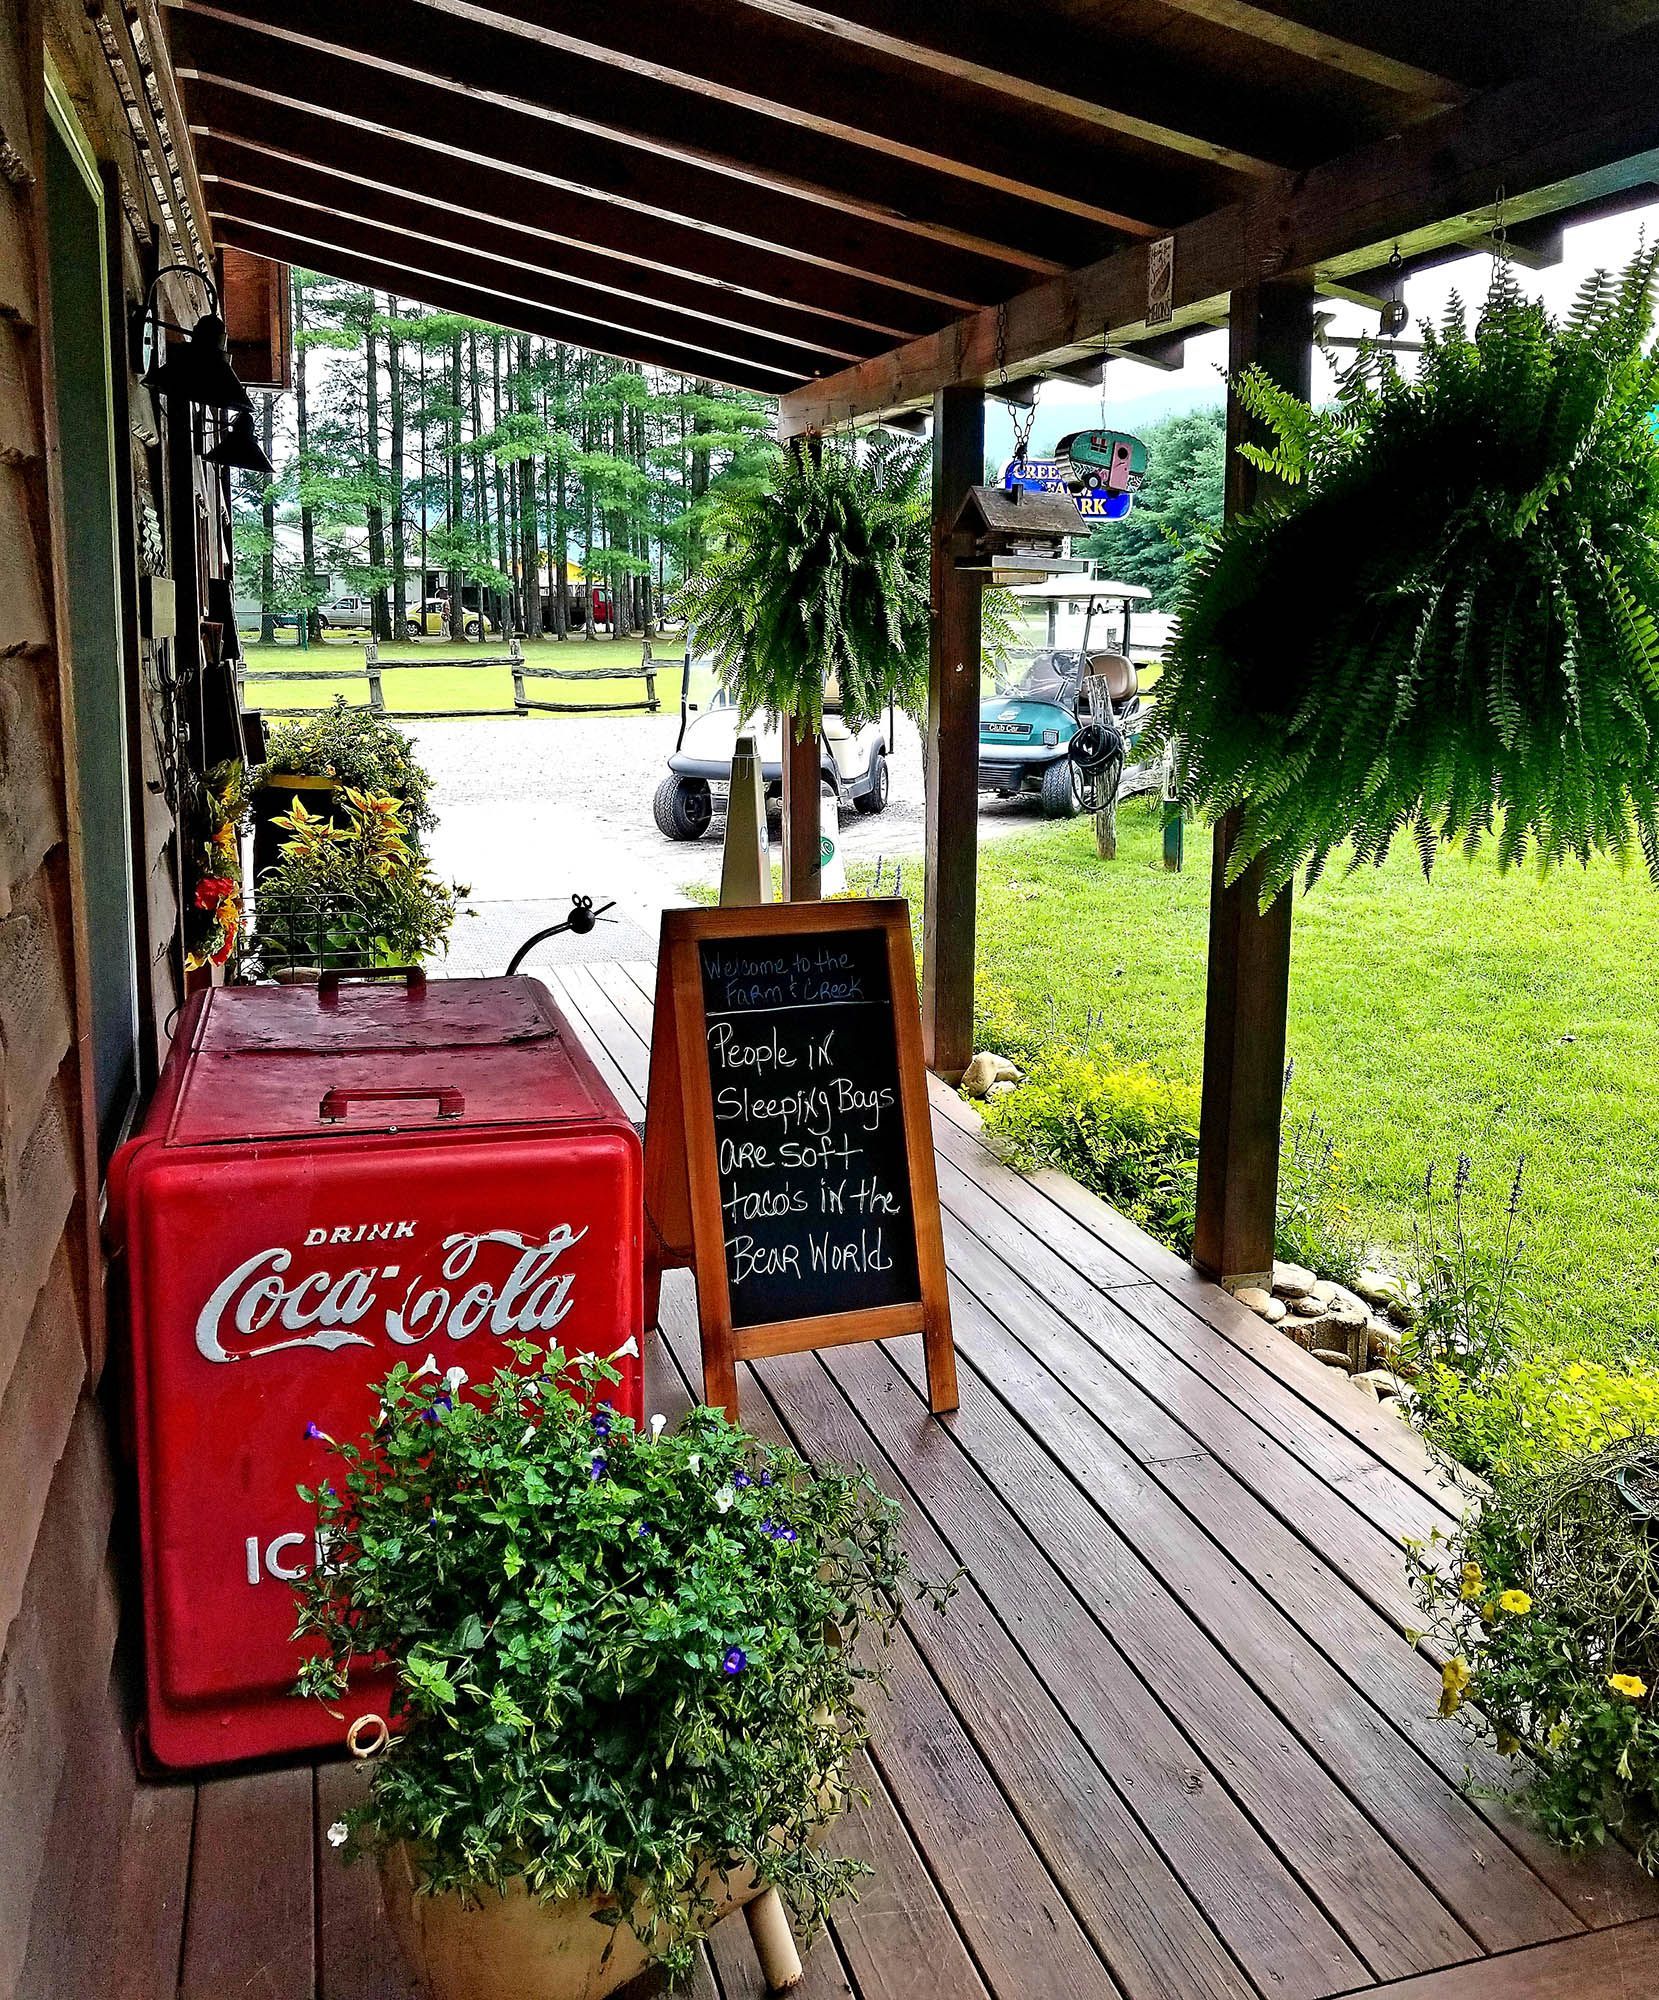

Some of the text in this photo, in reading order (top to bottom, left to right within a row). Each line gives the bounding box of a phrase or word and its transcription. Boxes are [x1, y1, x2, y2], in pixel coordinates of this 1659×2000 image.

[1013, 464, 1060, 479] CREE
[1046, 481, 1092, 497] FAM
[1073, 498, 1107, 515] RK
[989, 724, 1019, 733] Club Car
[703, 948, 855, 979] Welcome to the
[707, 1022, 797, 1076] People
[829, 1078, 895, 1131] Bags
[723, 1181, 808, 1224] taco's
[850, 1175, 900, 1214] the
[304, 1220, 419, 1246] DRINK
[195, 1222, 589, 1363] Coca-Cola
